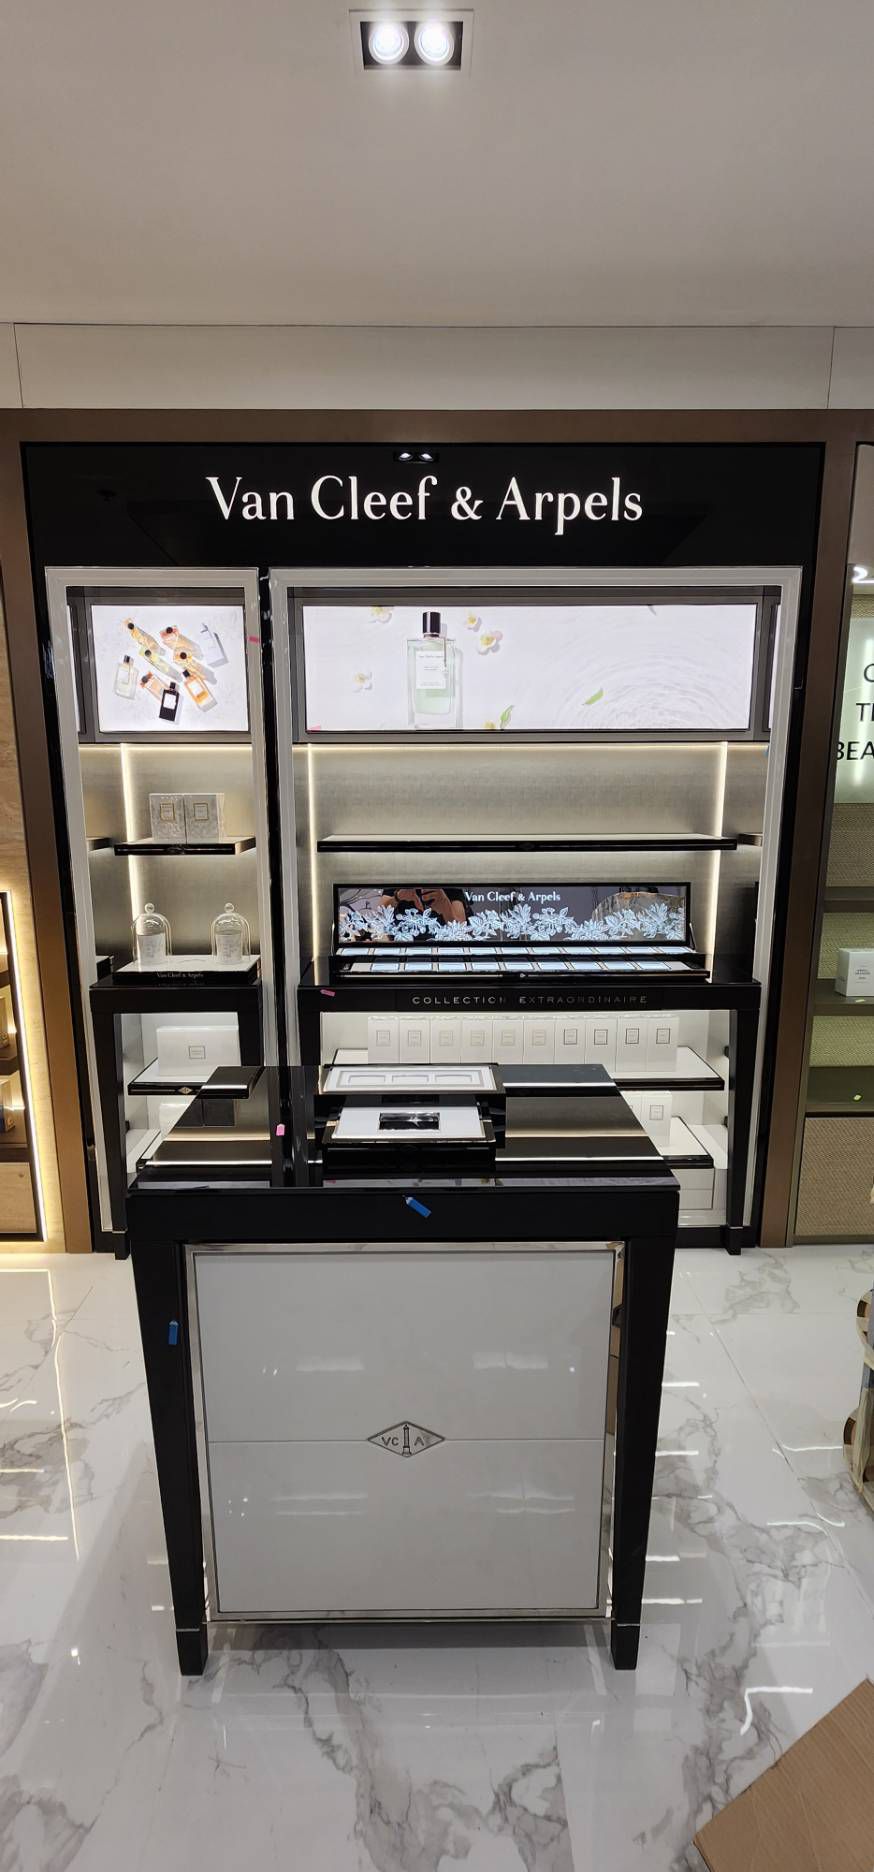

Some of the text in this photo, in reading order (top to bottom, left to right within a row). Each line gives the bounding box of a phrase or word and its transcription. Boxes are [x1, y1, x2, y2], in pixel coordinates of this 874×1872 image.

[205, 475, 644, 536] Van Cleef & Arpels
[855, 702, 874, 722] T
[464, 891, 561, 904] Van Cleef & Arpels
[381, 1436, 399, 1446] VC
